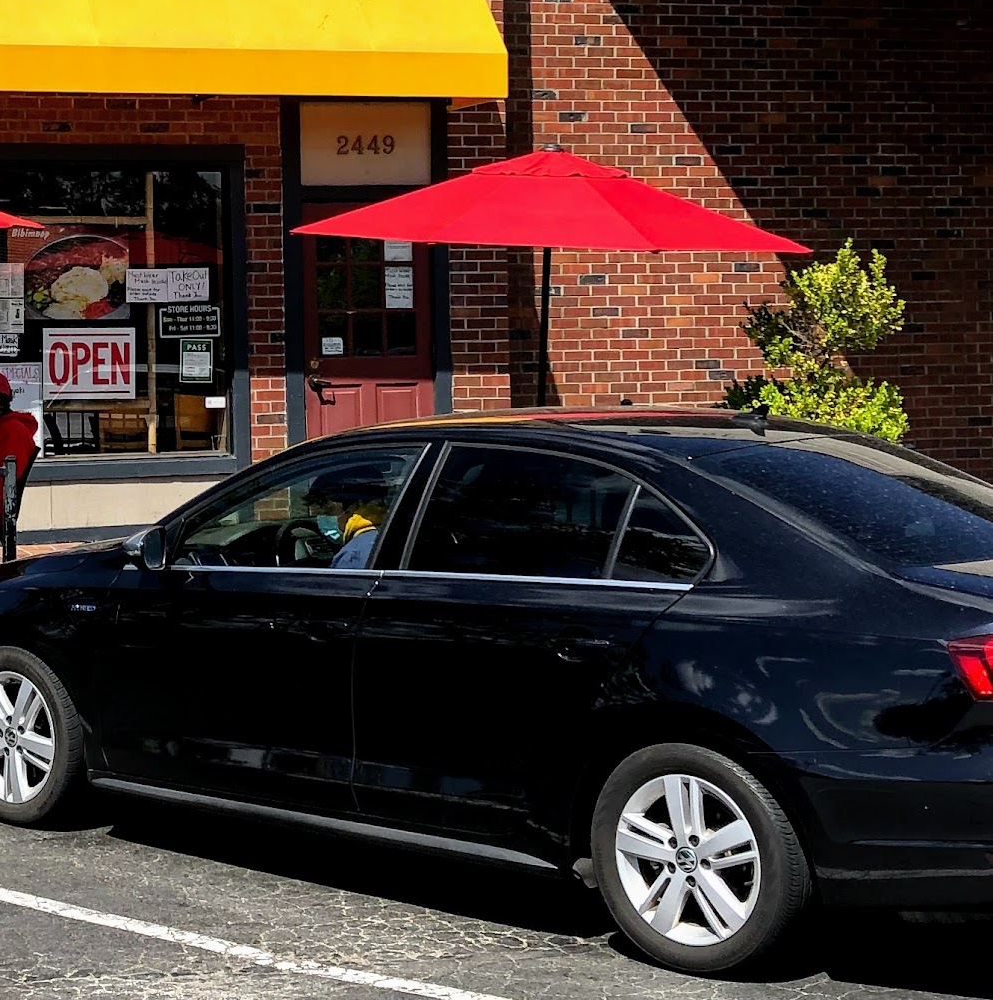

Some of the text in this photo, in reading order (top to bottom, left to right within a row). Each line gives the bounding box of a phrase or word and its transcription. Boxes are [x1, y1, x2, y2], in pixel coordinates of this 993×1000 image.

[336, 135, 395, 155] 2449
[167, 304, 213, 313] STORE HOURS
[48, 341, 131, 387] OPEN
